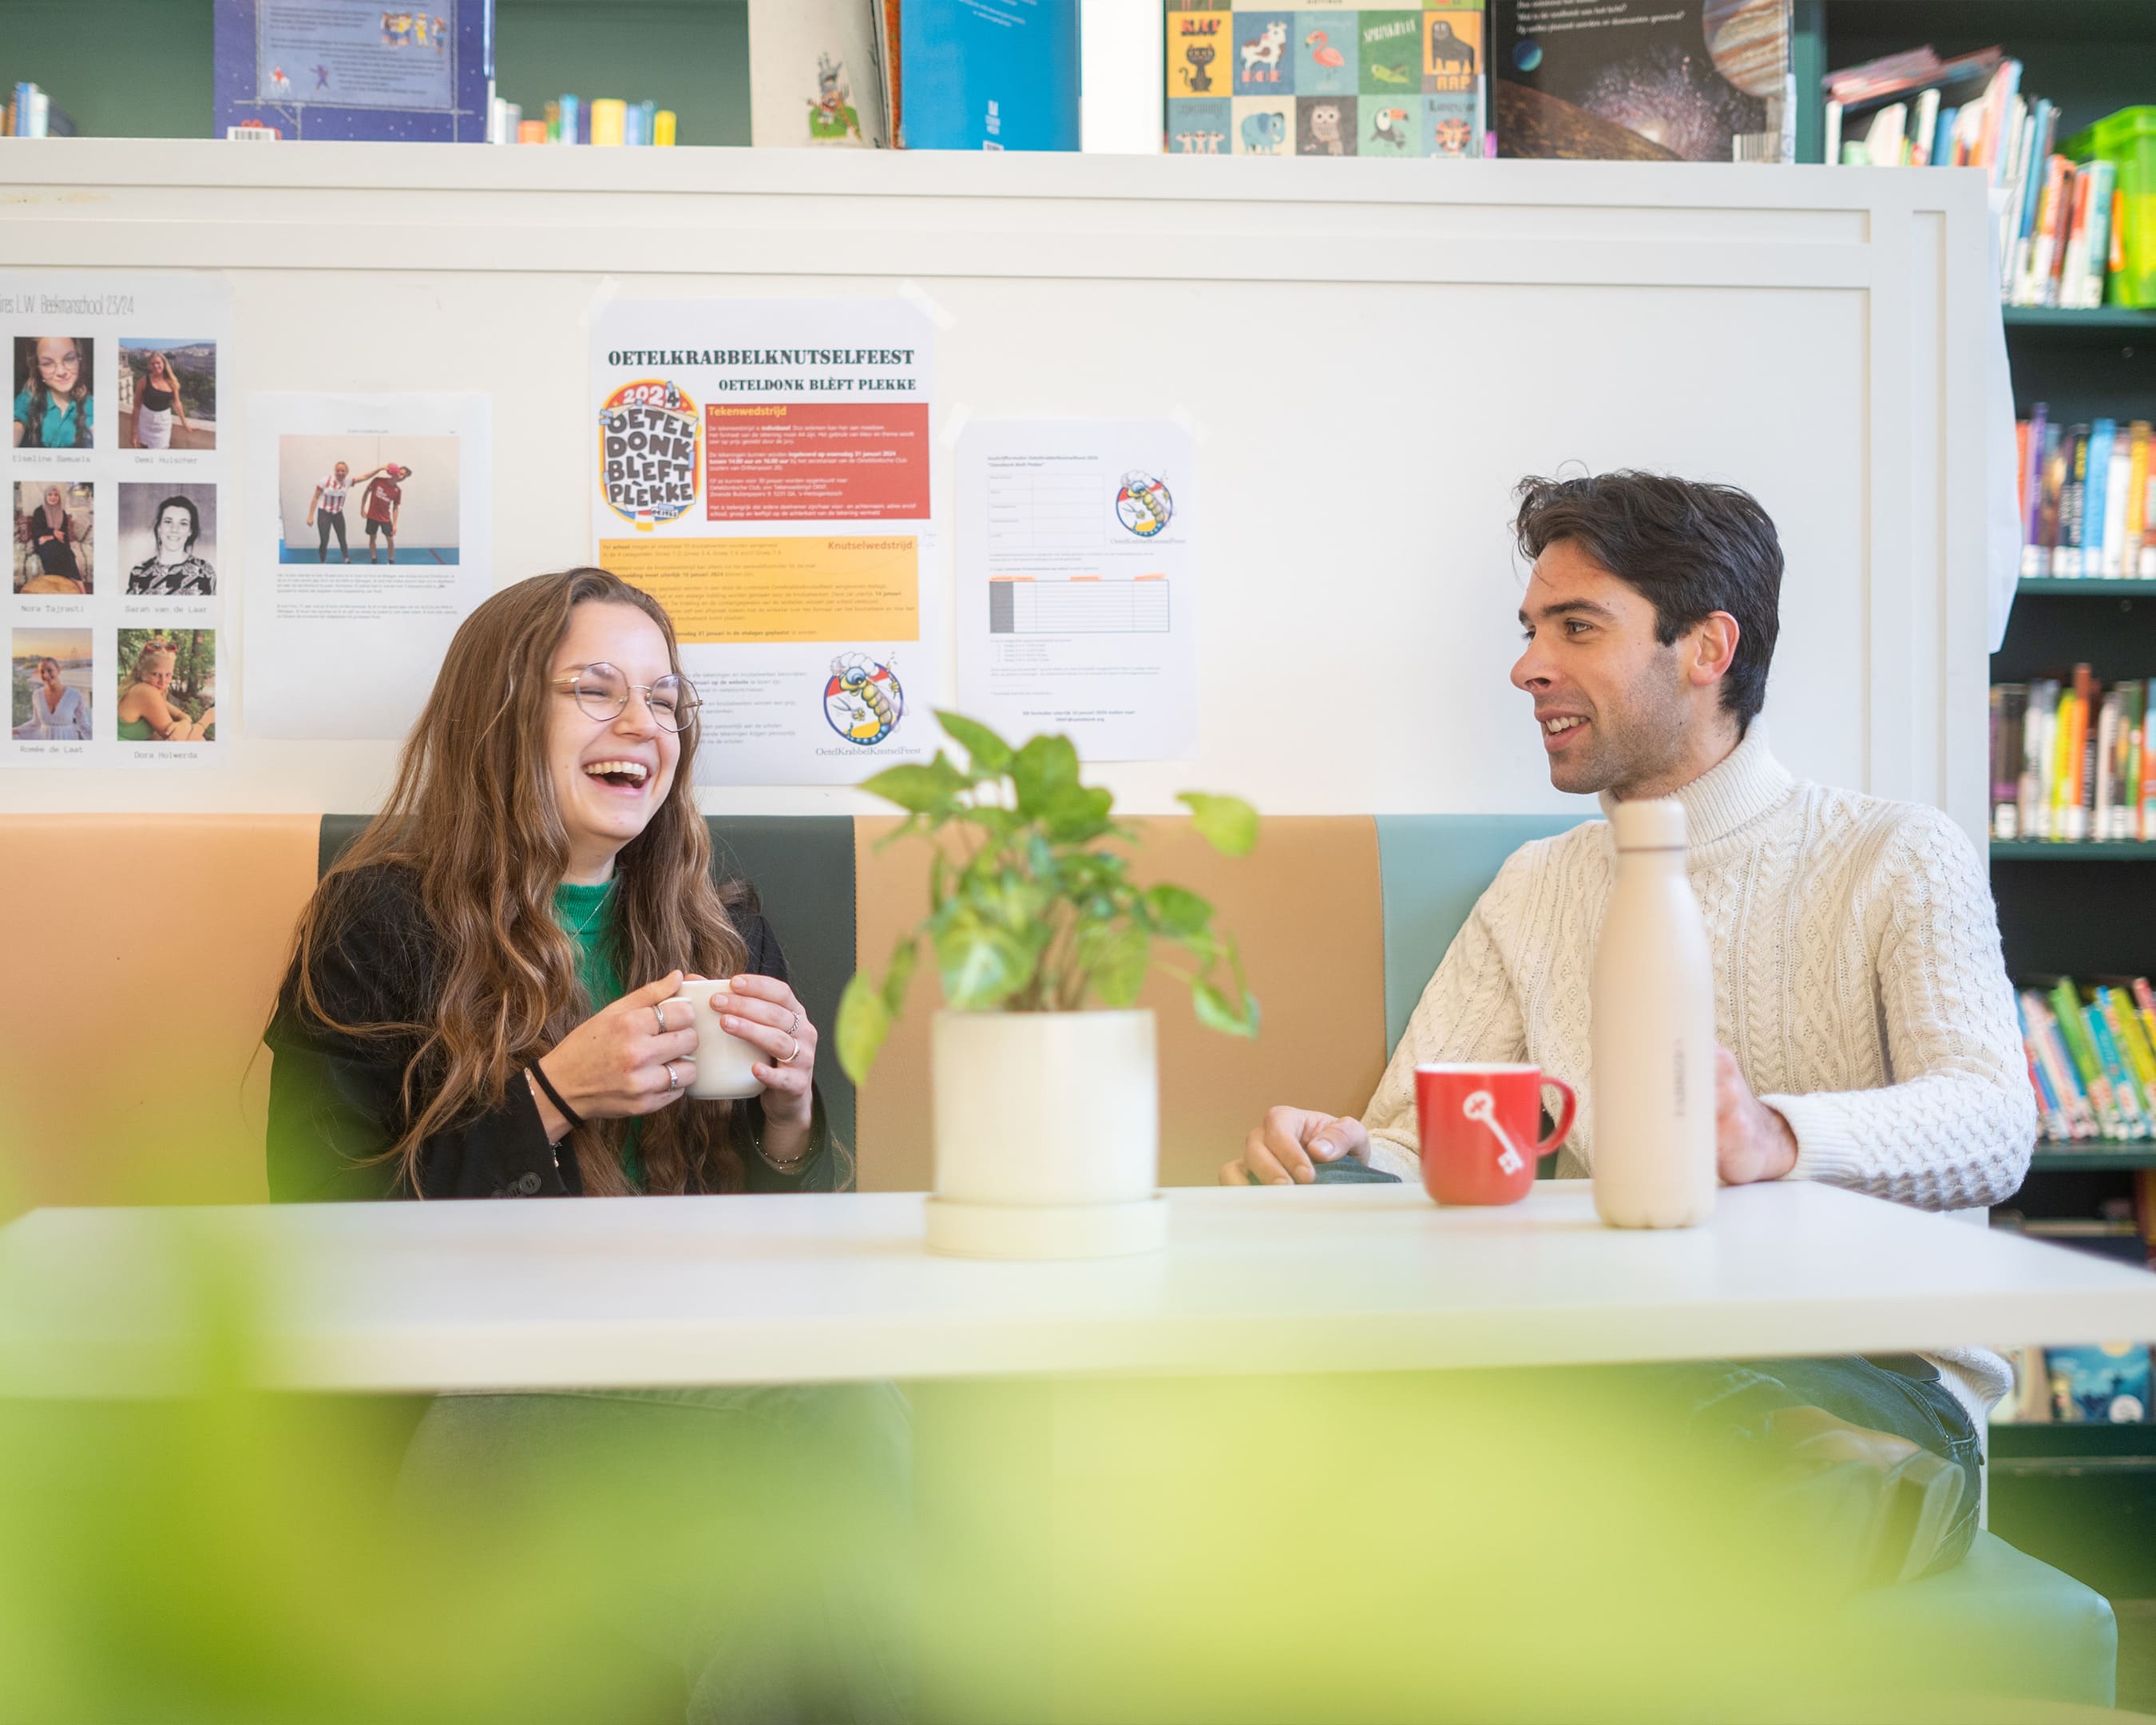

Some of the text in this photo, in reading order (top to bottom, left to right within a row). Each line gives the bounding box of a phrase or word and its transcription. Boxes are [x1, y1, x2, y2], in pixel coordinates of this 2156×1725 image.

[1437, 75, 1471, 91] AAP
[608, 350, 914, 366] OETELKRABBELKNUTSELFEEST
[719, 379, 805, 391] OETELDONK
[858, 379, 917, 391] PLEKKE
[623, 387, 680, 408] 2024
[708, 406, 787, 418] Tekenwedstrijd
[607, 431, 692, 460] DONK
[828, 541, 913, 551] Knutselwedstrijd
